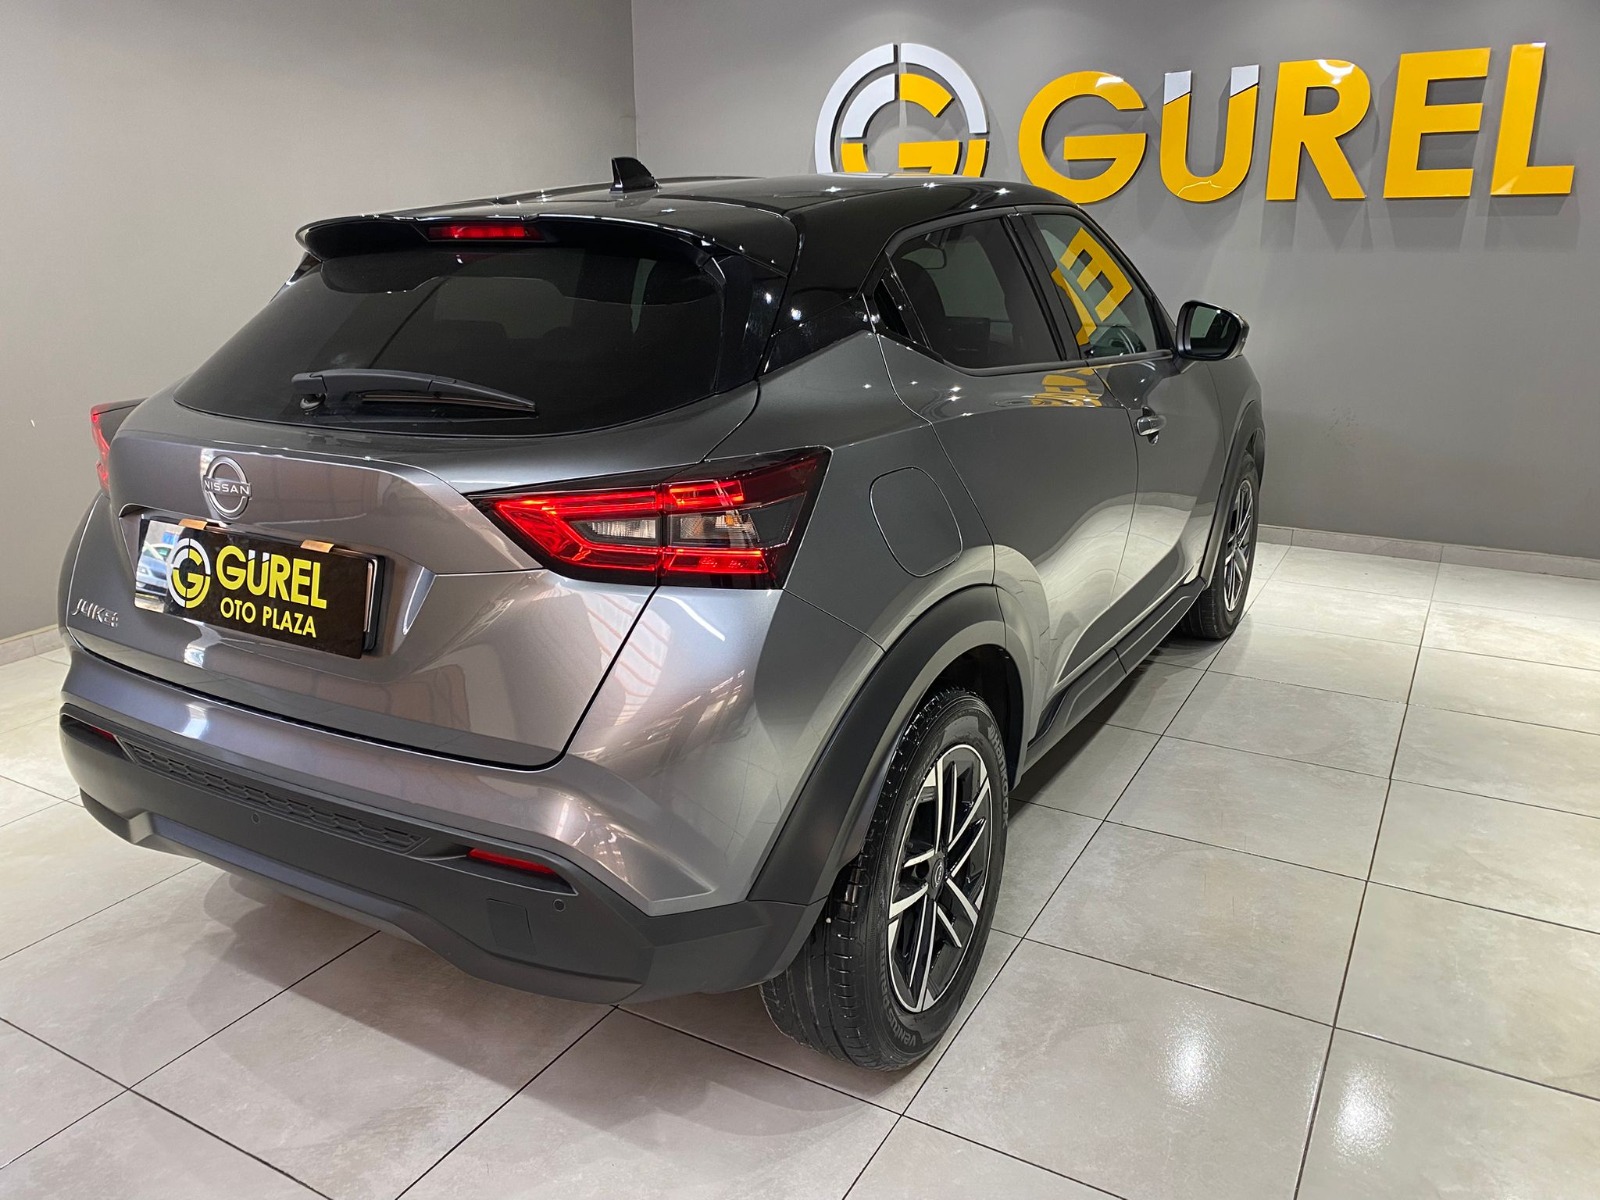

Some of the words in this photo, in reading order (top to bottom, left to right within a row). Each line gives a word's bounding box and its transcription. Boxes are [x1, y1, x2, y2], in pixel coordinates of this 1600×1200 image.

[204, 479, 250, 495] NISSAN
[220, 597, 256, 623] OTO
[262, 605, 316, 638] PLAZA
